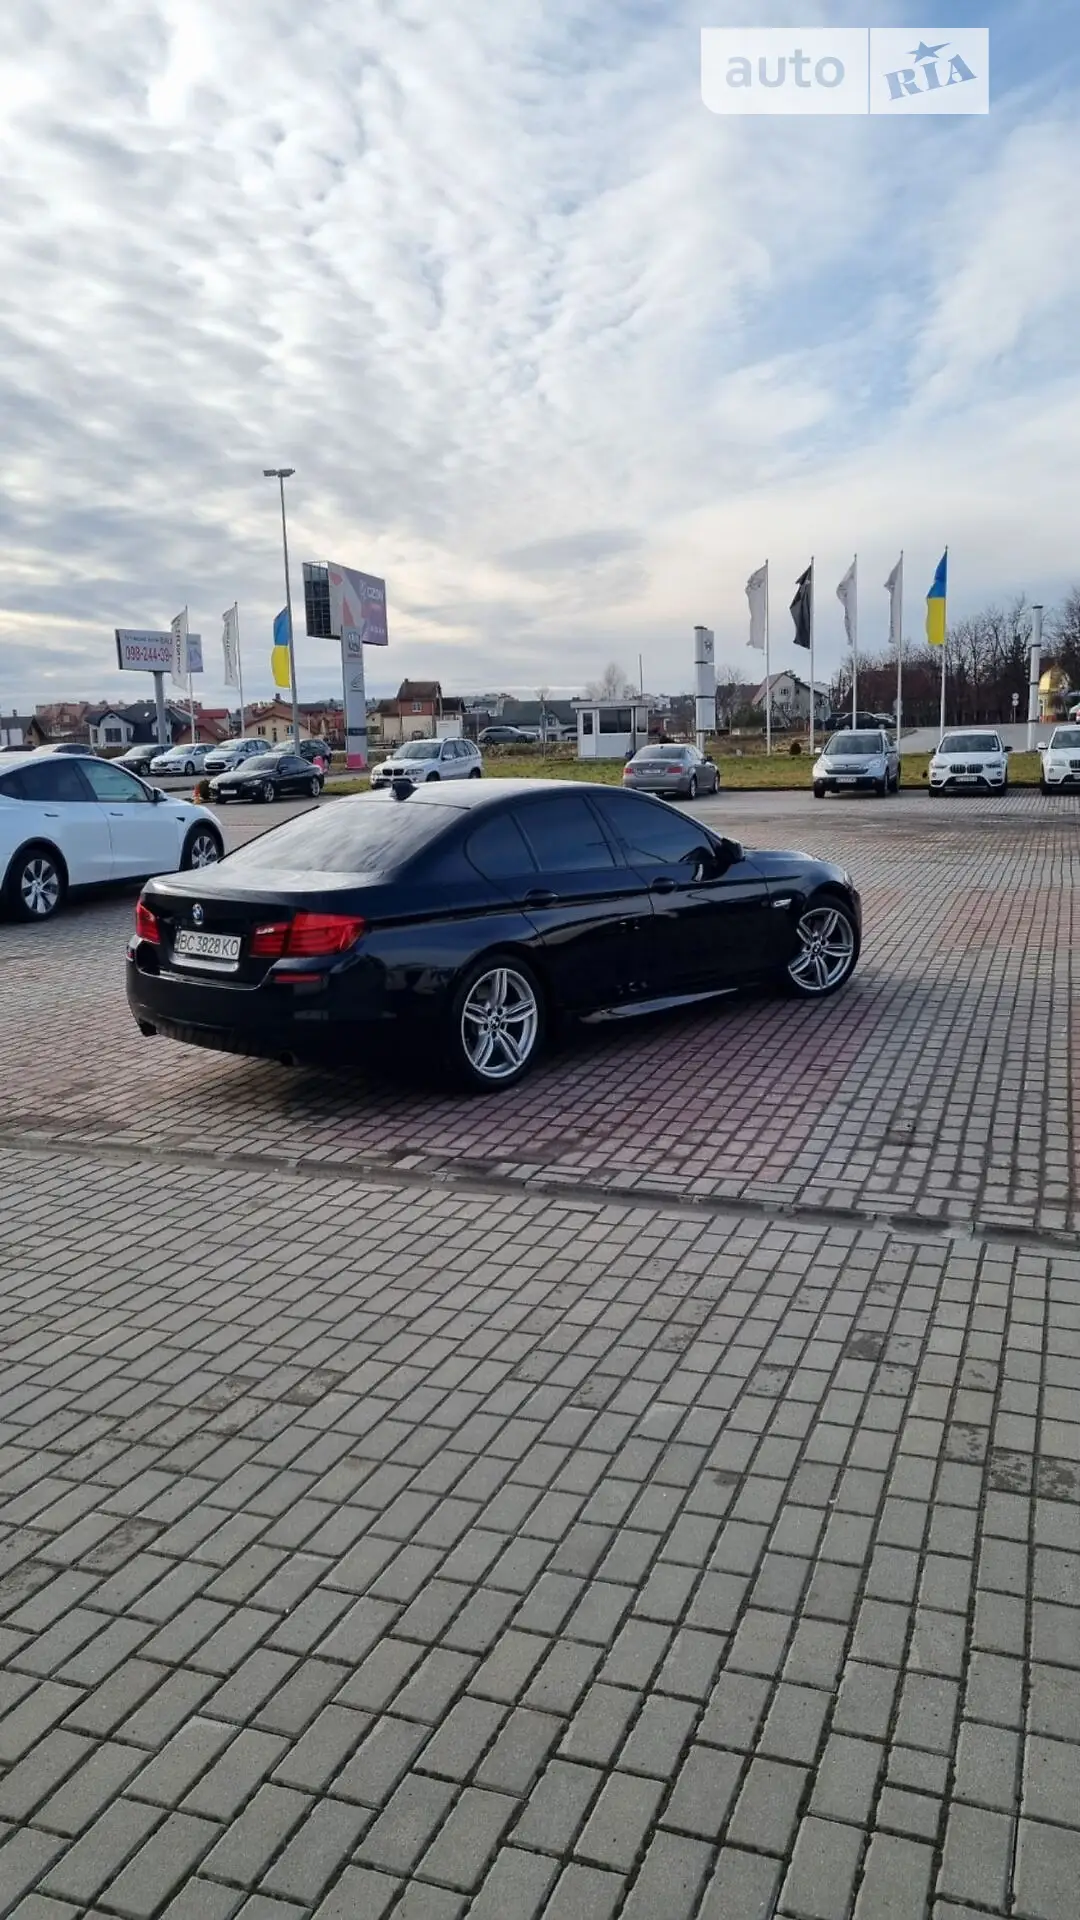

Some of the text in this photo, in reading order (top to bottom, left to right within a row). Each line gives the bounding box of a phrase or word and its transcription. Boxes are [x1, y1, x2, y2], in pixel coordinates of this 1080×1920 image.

[179, 934, 239, 956] BC 3828 KO
